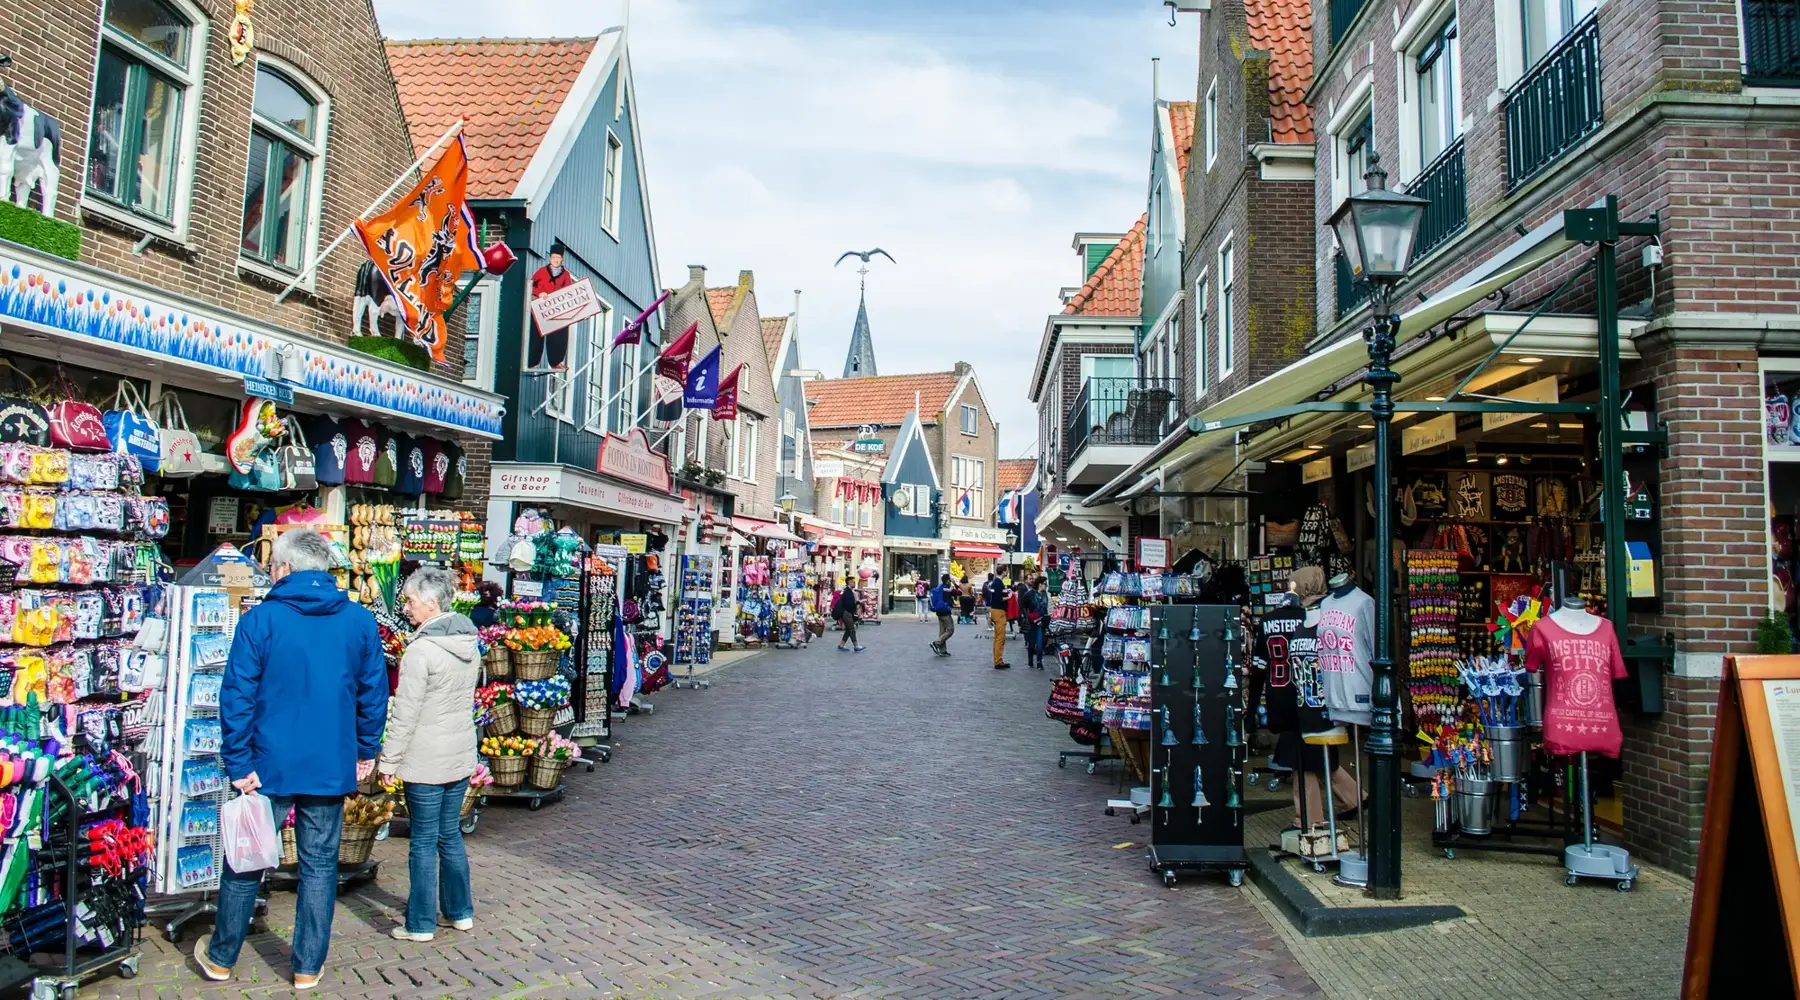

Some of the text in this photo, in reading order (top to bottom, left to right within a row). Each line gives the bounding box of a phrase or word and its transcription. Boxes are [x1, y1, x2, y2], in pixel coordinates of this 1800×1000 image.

[538, 284, 587, 311] FOTO'S IN
[540, 293, 591, 319] KOSTUUM
[246, 381, 277, 397] HEINEKEN
[686, 396, 715, 405] Informatie
[855, 443, 884, 451] DE KOE
[607, 446, 664, 481] FOTO'S IN KOSTUUM
[501, 474, 550, 485] Giftshop
[521, 483, 547, 491] Boer
[577, 481, 605, 499] Souvenirs
[617, 492, 637, 508] Giftshop
[638, 500, 644, 508] de
[644, 498, 654, 509] Boer
[961, 530, 973, 538] Fish
[980, 531, 996, 539] Chips
[1340, 638, 1353, 651] 75
[1562, 655, 1604, 673] CITY
